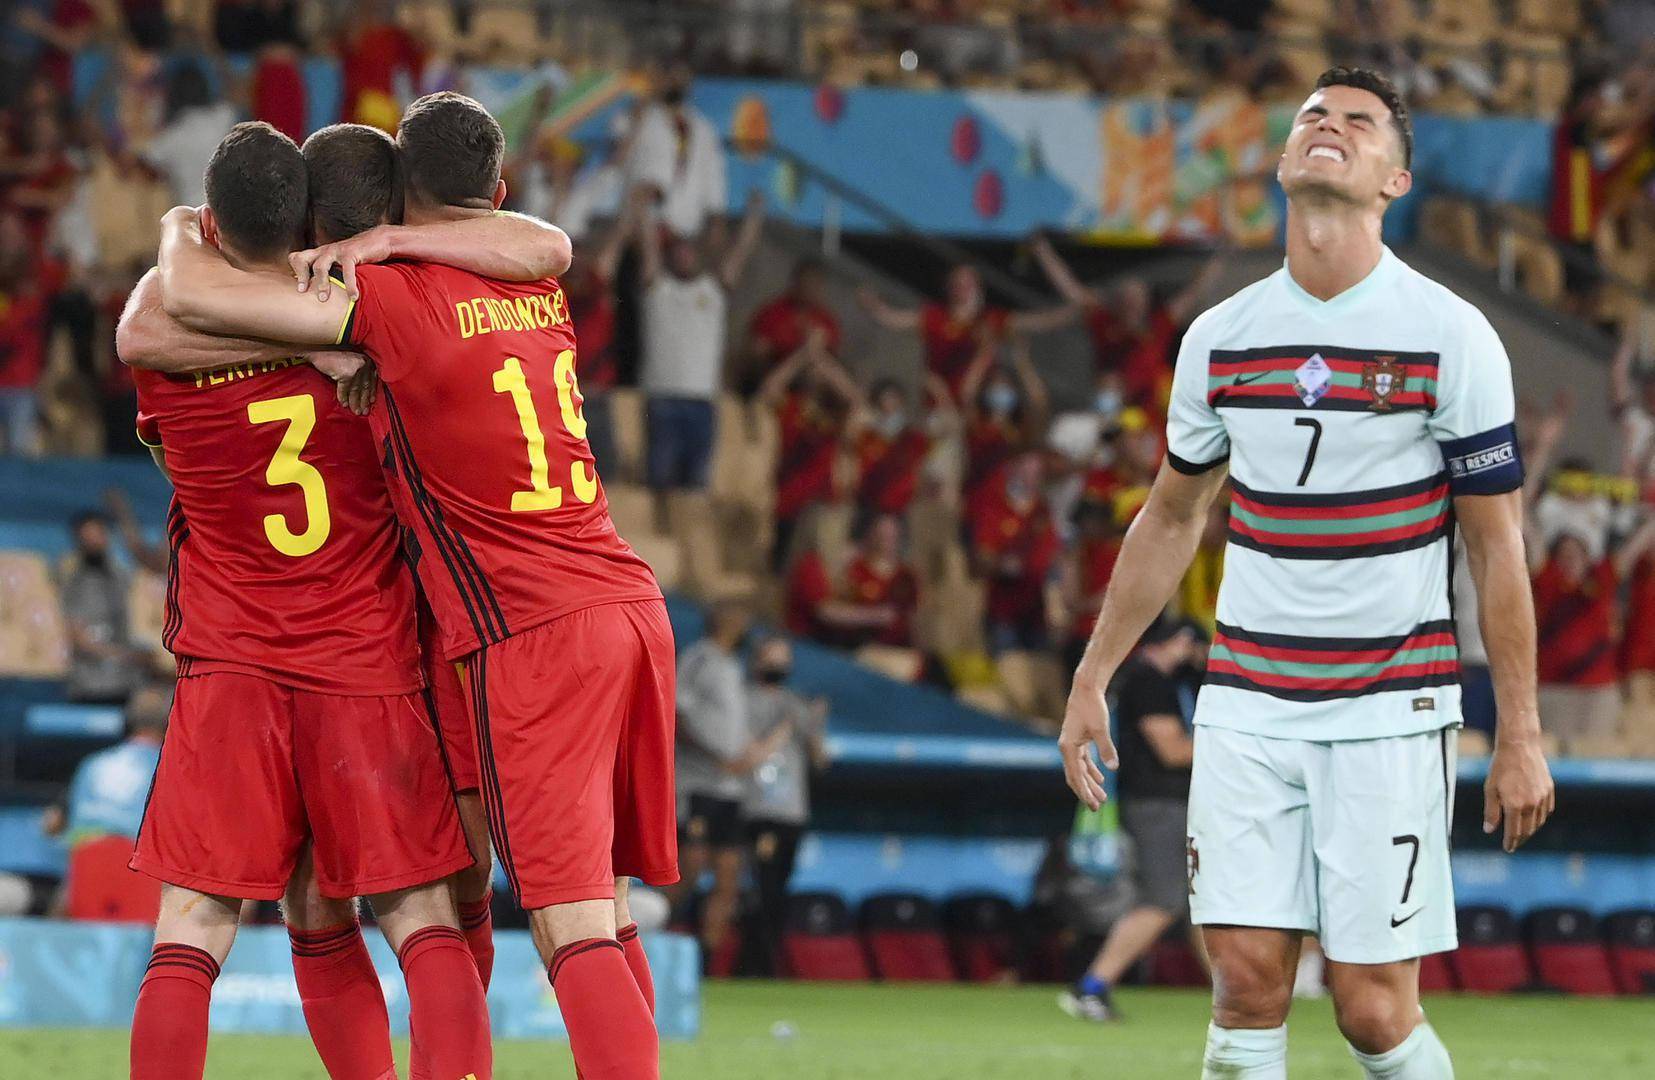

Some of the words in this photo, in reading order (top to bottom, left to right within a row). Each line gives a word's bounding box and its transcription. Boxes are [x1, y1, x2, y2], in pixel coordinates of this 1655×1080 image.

[456, 288, 570, 339] DENDONCKE
[492, 349, 598, 512] 19
[1294, 417, 1322, 486] 7
[1465, 445, 1514, 471] RESPECT
[247, 393, 331, 557] 3
[1392, 834, 1419, 904] 7
